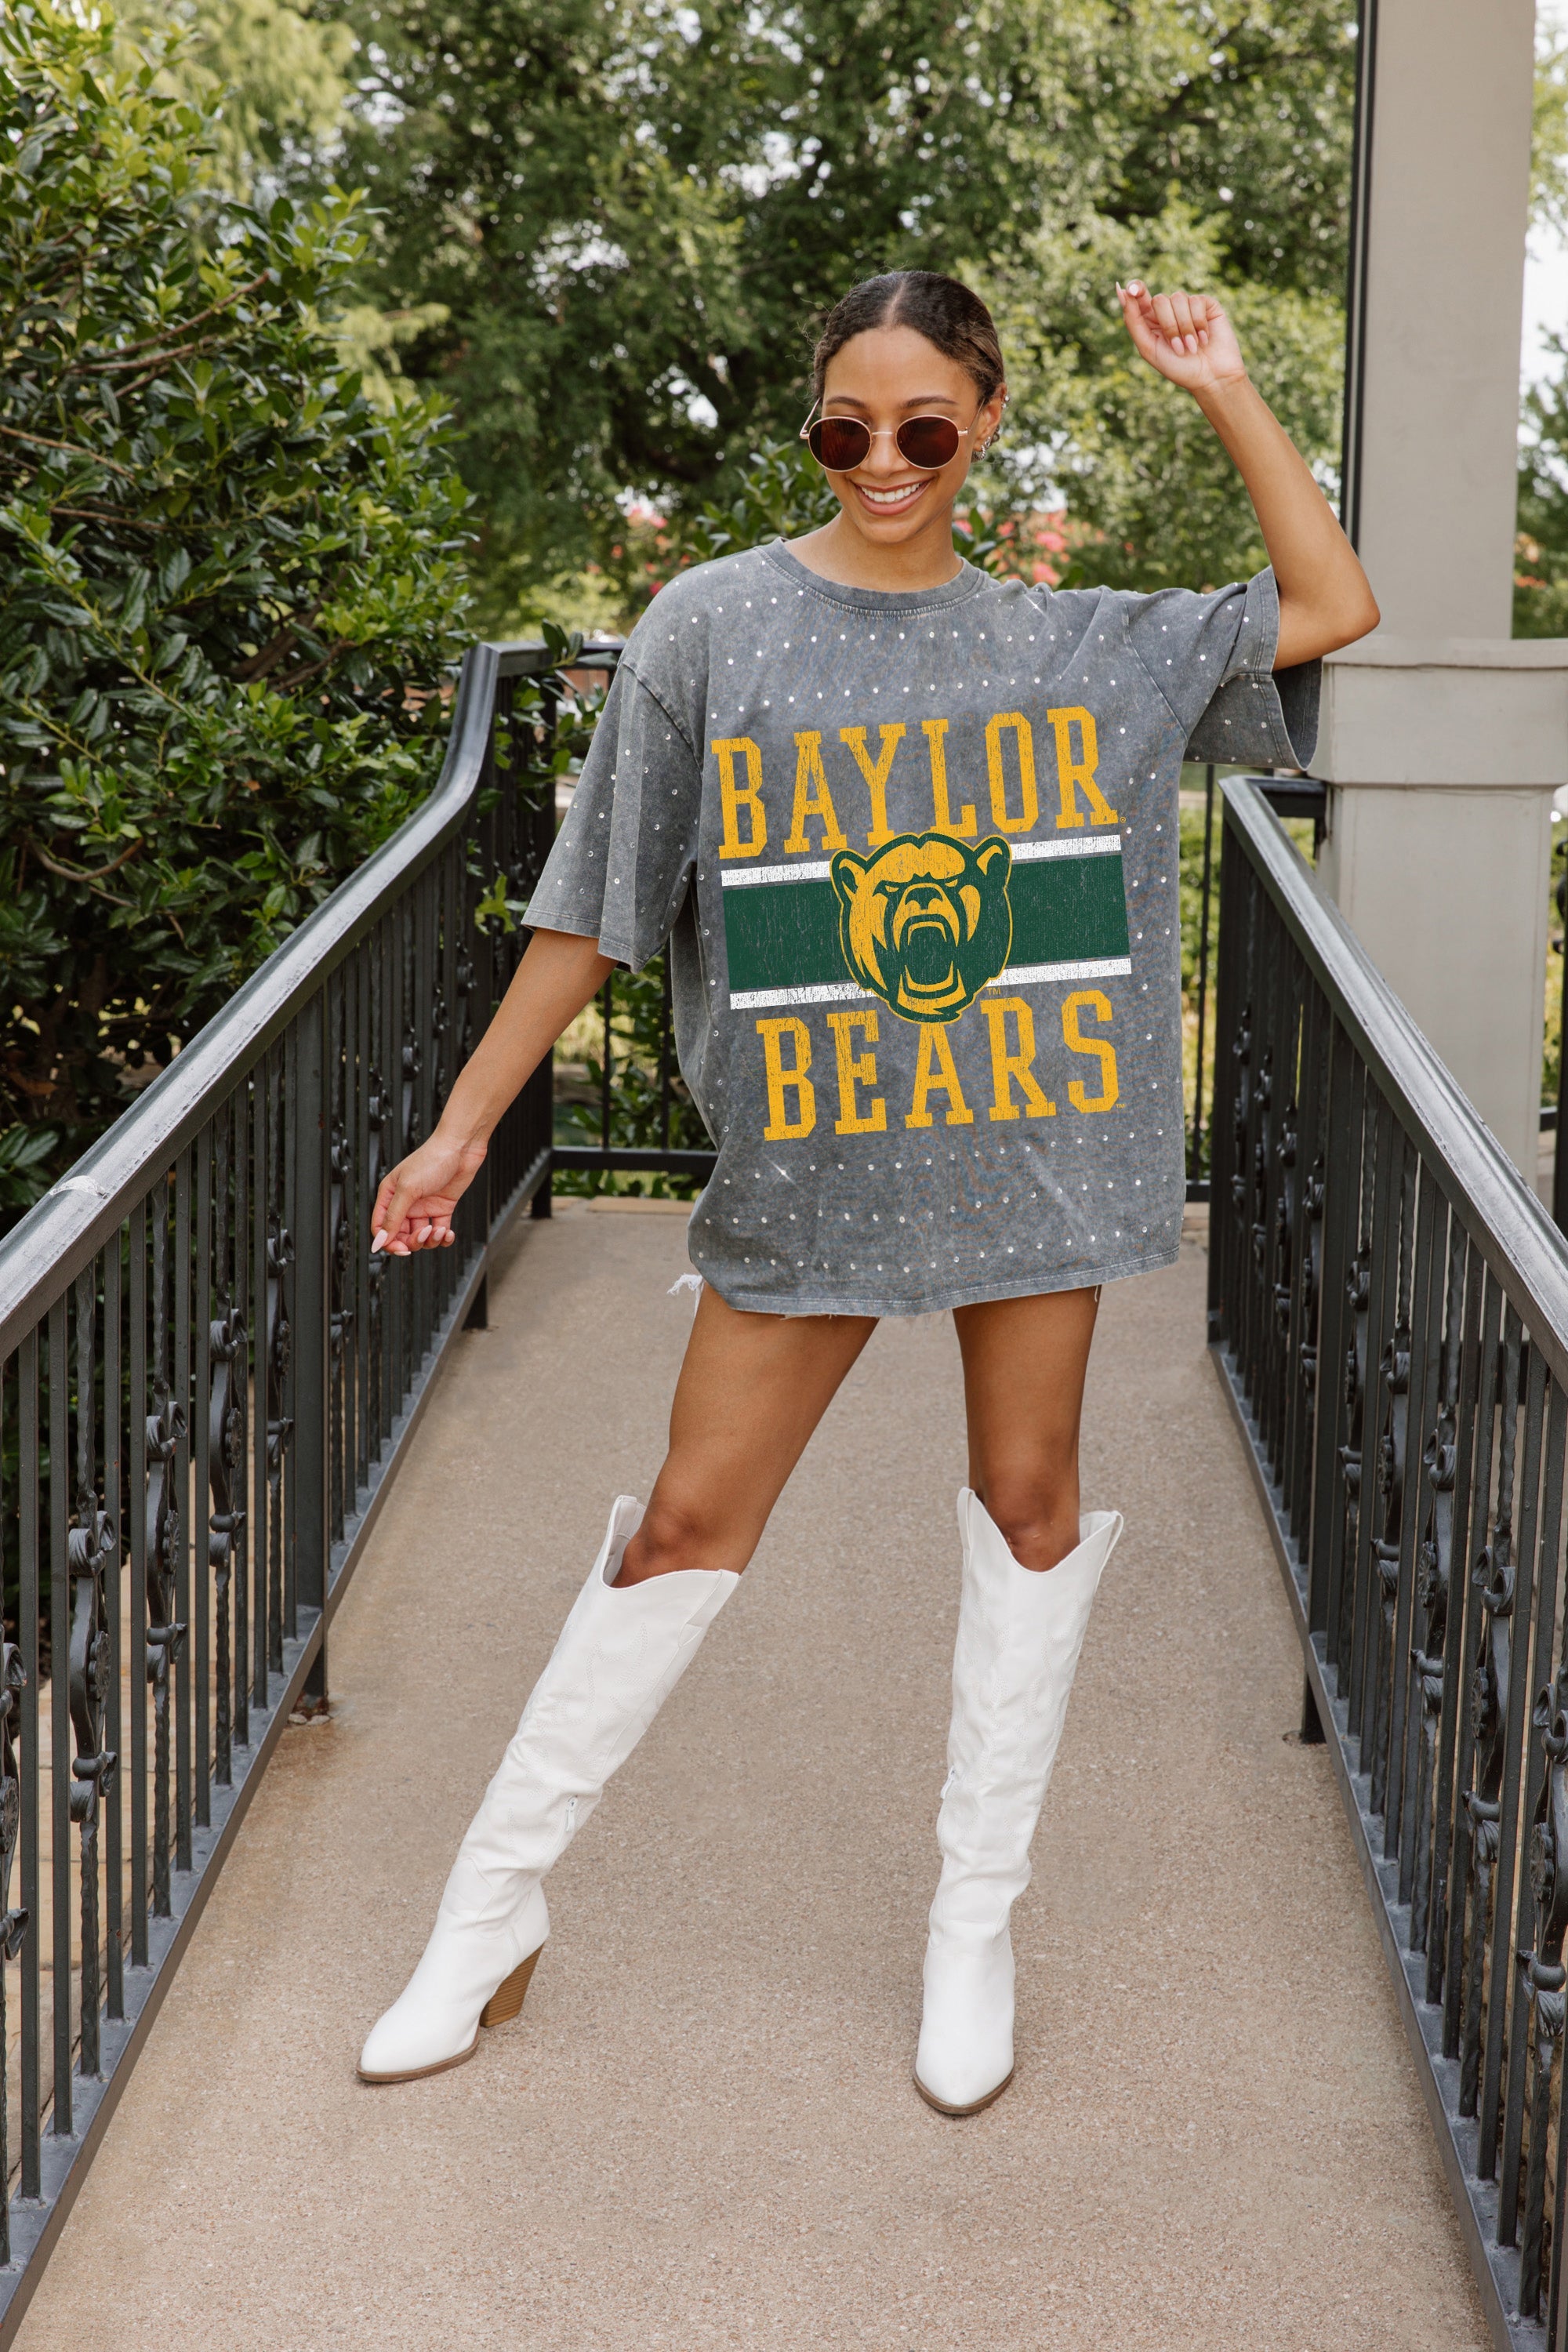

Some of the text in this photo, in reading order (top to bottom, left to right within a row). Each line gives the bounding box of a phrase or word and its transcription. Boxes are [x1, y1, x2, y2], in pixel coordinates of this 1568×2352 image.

[711, 706, 1119, 860] BAYLOR
[756, 989, 1120, 1142] BEARS
[987, 987, 1001, 996] TM
